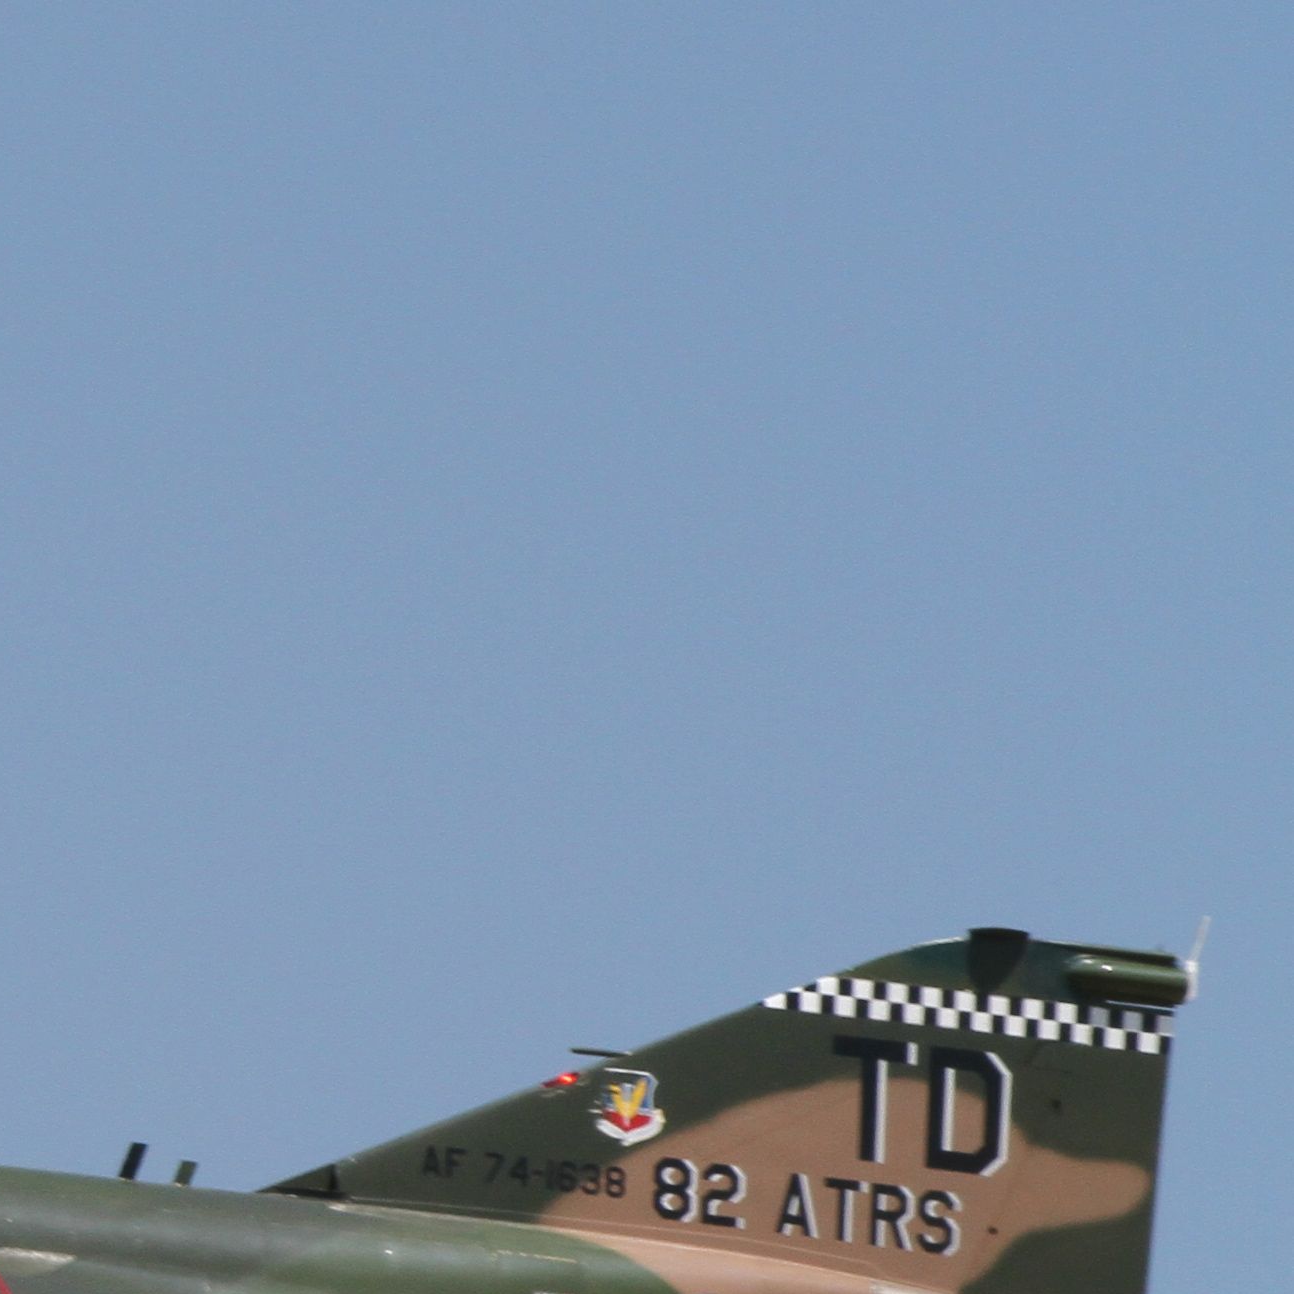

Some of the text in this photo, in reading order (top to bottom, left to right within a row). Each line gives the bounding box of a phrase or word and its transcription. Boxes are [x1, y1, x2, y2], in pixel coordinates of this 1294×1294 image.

[832, 1034, 1012, 1177] TD
[422, 1147, 627, 1199] AF 74-1638
[654, 1157, 963, 1258] 82 ATRS
